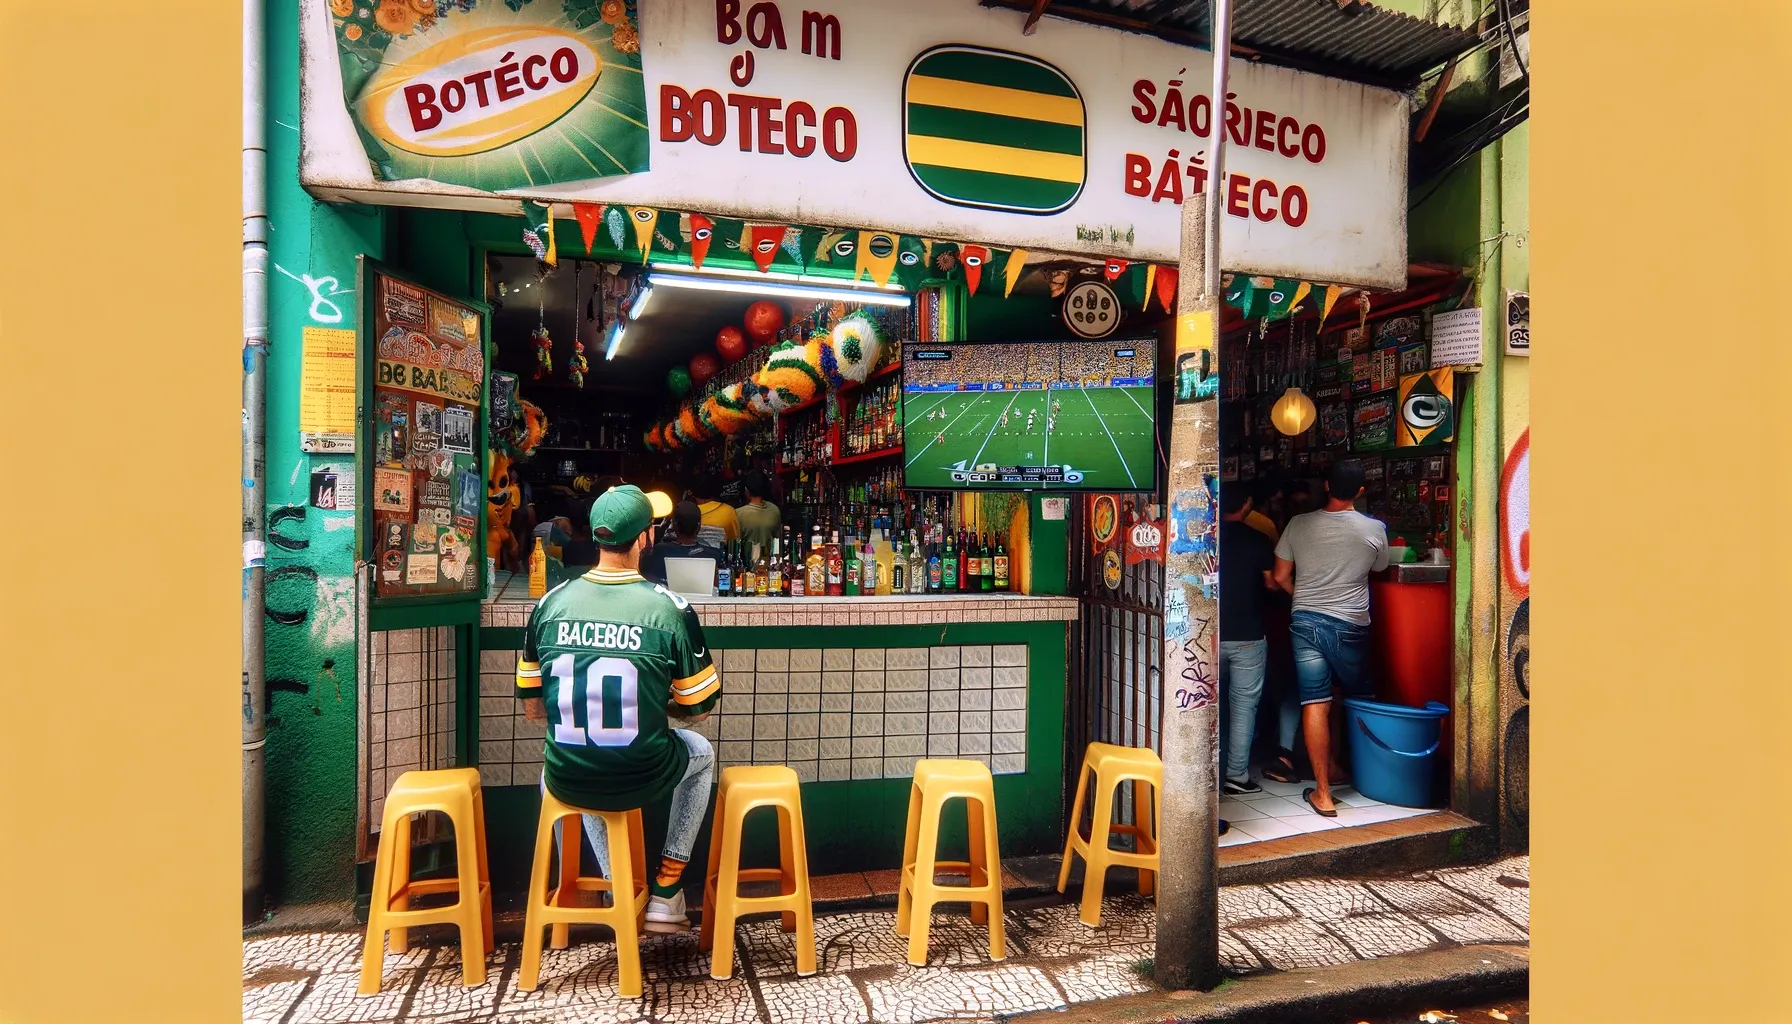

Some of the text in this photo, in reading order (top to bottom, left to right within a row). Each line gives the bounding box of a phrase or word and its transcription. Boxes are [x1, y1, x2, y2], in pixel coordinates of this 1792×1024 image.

[403, 47, 579, 132] BOTÉCO
[660, 84, 857, 163] BOTECO
[556, 622, 642, 650] BACEBOS
[551, 653, 639, 747] 10
